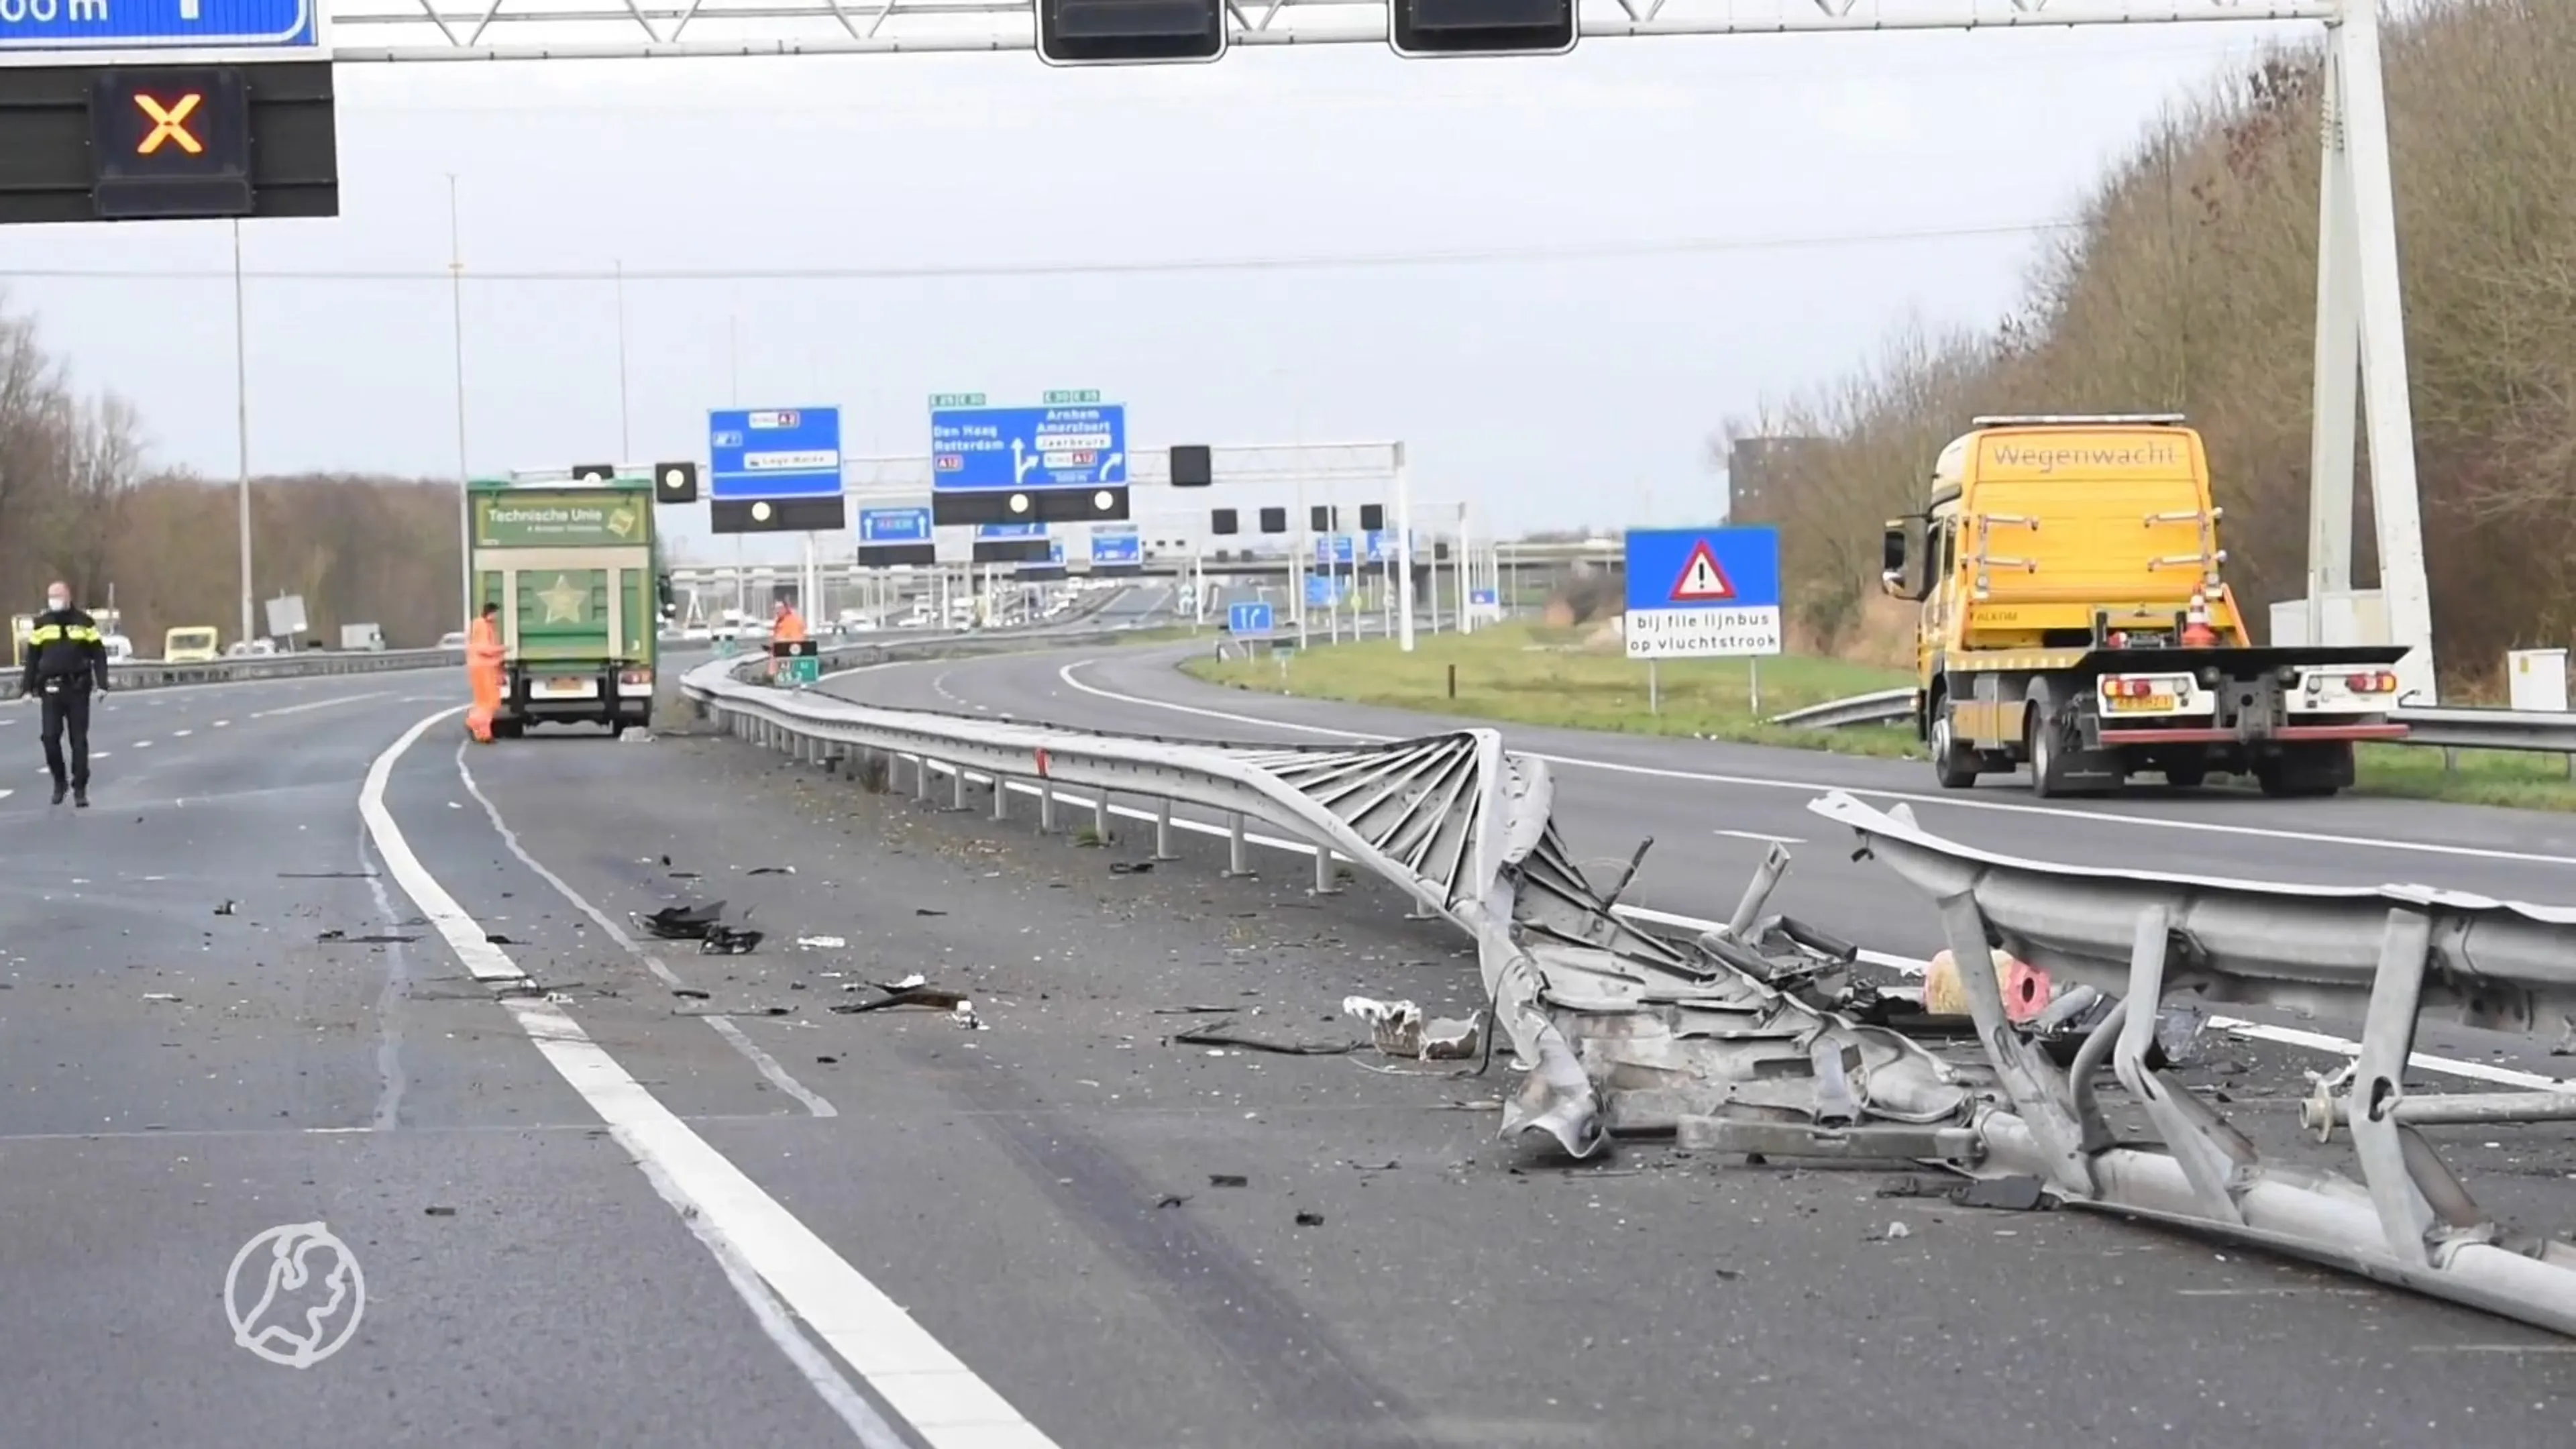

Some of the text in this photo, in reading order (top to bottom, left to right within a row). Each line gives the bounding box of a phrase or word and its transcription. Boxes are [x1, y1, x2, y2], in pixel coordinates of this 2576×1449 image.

[1993, 440, 2176, 474] Wegenwacht
[488, 508, 602, 523] Technische Unie
[1637, 612, 1770, 632] bij file lijnbus
[1630, 633, 1777, 651] op vluchtstrook
